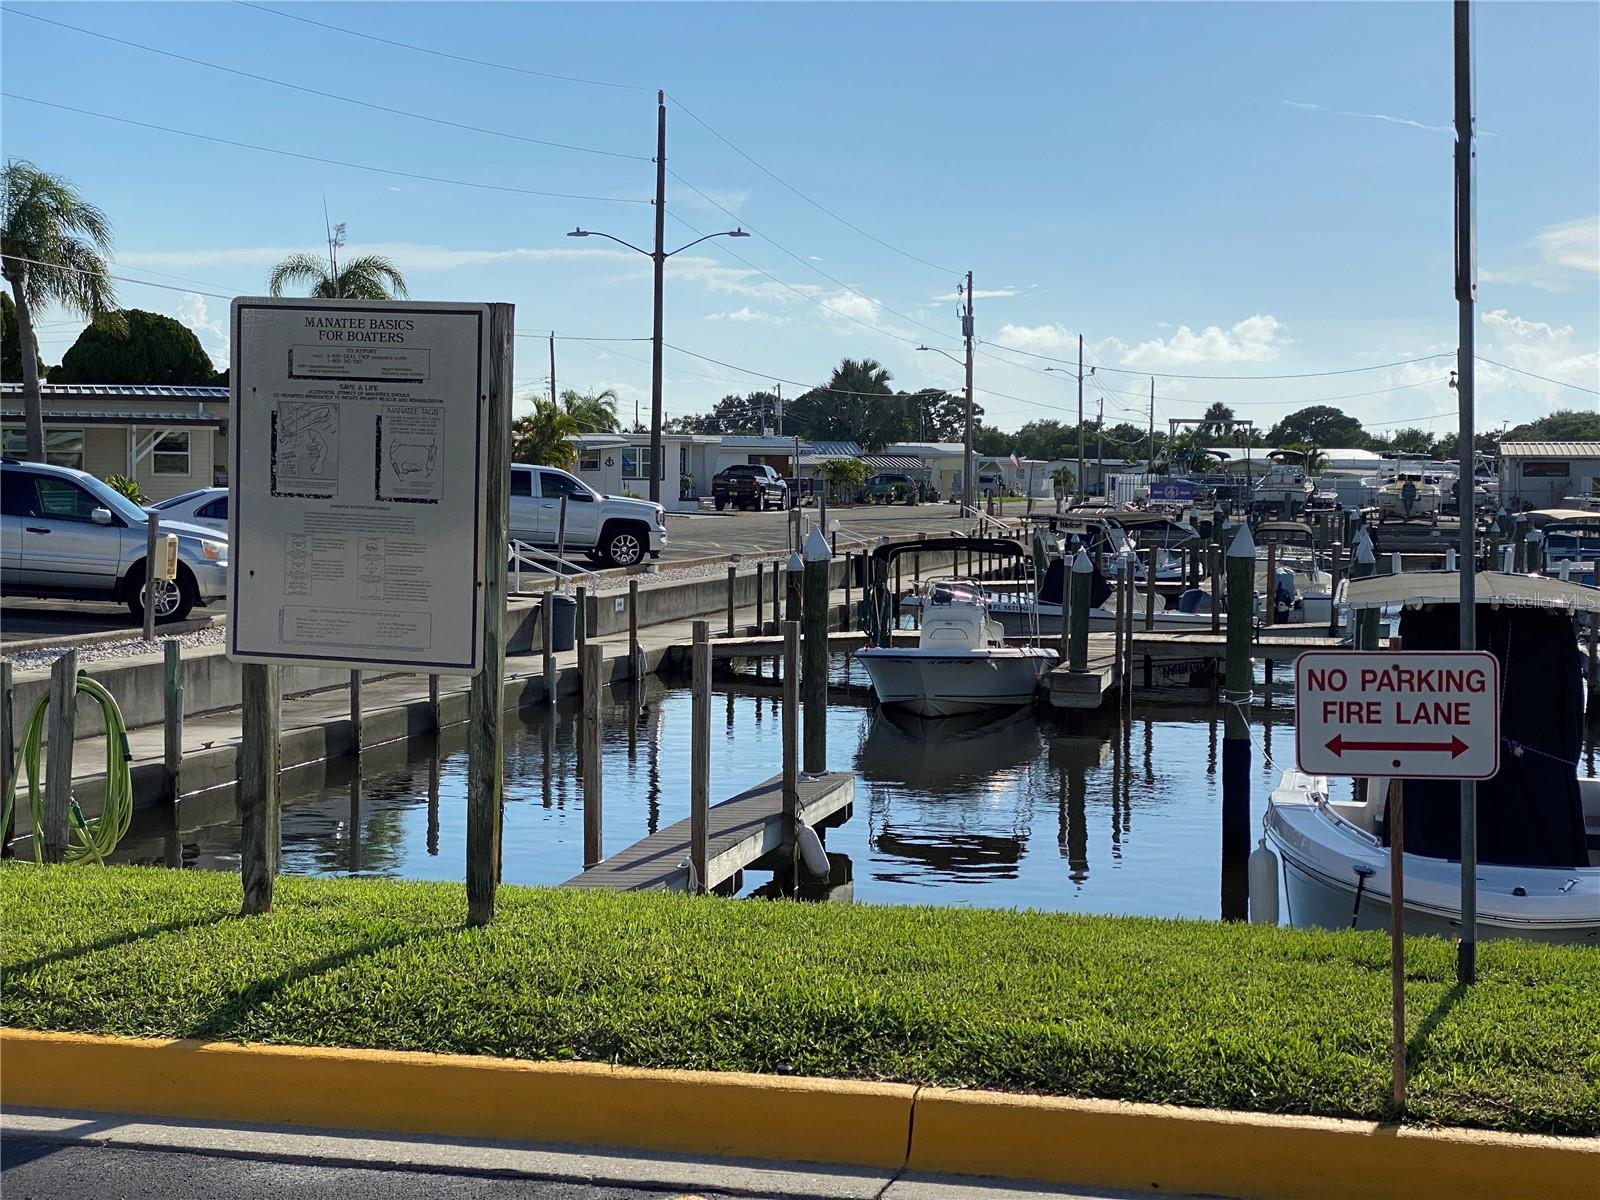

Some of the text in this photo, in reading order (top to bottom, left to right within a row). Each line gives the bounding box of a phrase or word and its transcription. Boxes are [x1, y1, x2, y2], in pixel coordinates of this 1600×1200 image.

[305, 317, 414, 330] MANATEE BASICS
[319, 331, 405, 343] FOR BOATERS
[1307, 668, 1486, 693] NO PARKING
[1322, 701, 1471, 725] FIRE LANE
